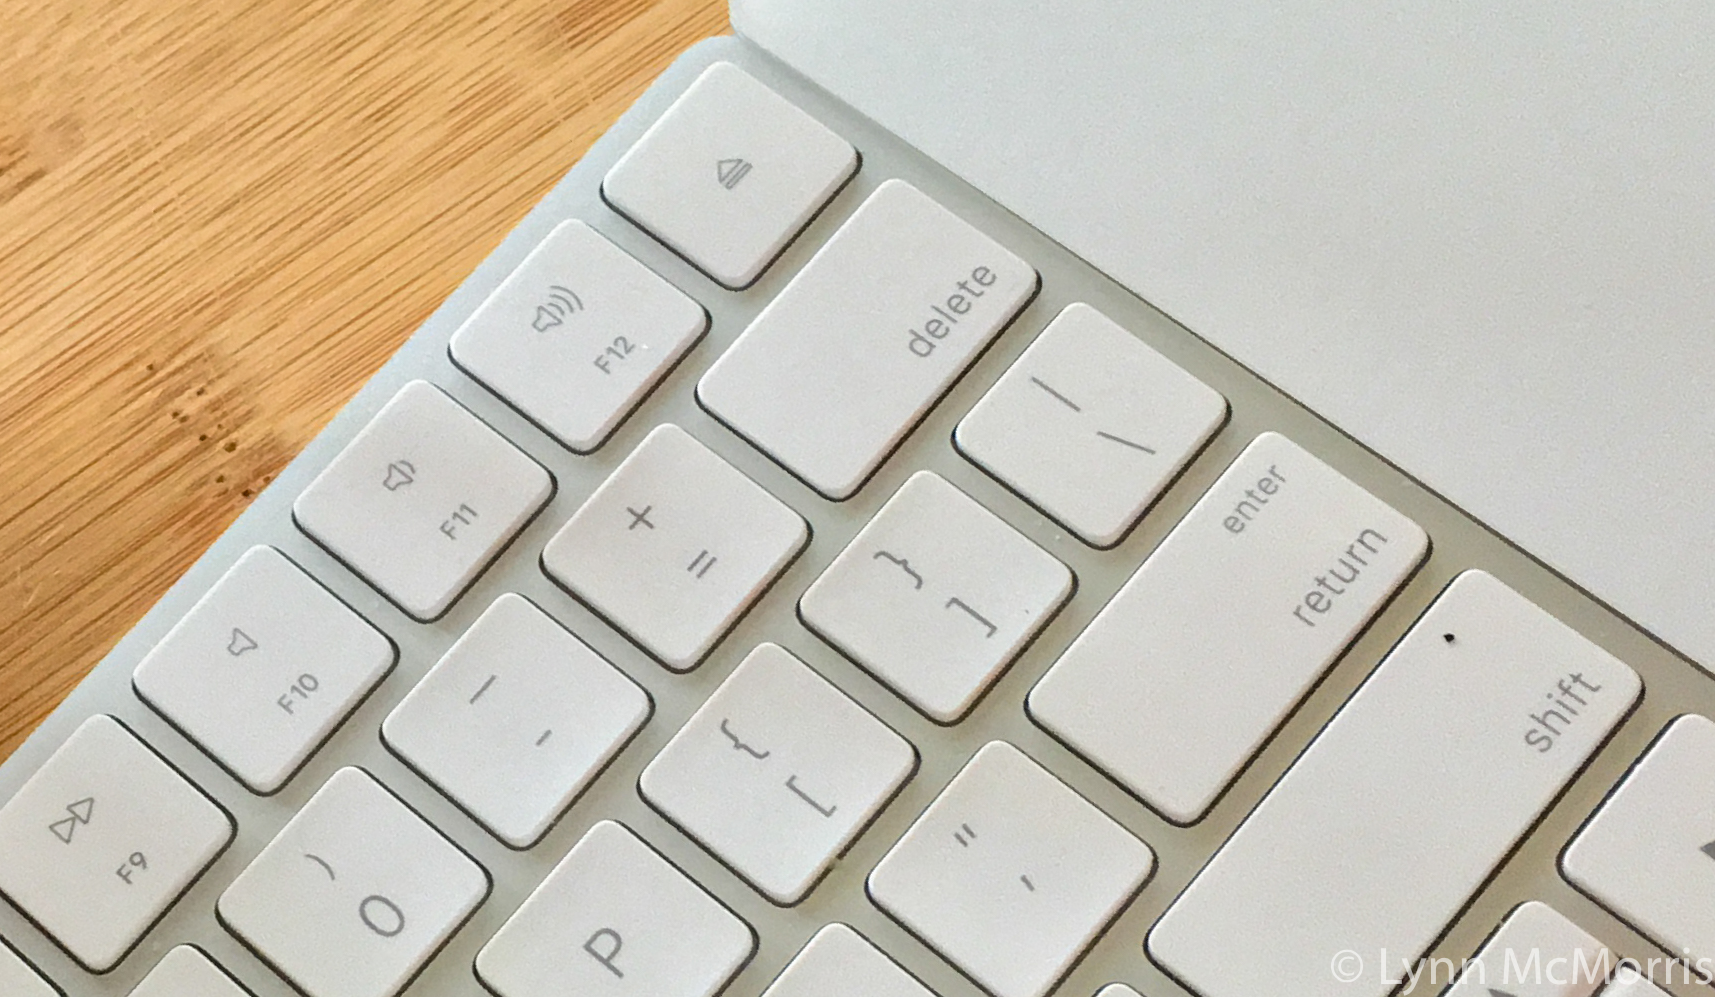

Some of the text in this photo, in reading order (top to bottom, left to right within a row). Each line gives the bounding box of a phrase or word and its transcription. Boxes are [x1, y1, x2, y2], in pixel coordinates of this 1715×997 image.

[907, 263, 998, 360] delete
[593, 335, 636, 375] F12
[439, 502, 479, 541] F11
[1222, 464, 1287, 535] enter
[1292, 526, 1388, 628] return
[276, 672, 320, 715] F10
[1523, 671, 1602, 754] shift
[115, 851, 148, 886] F9
[582, 927, 625, 980] P
